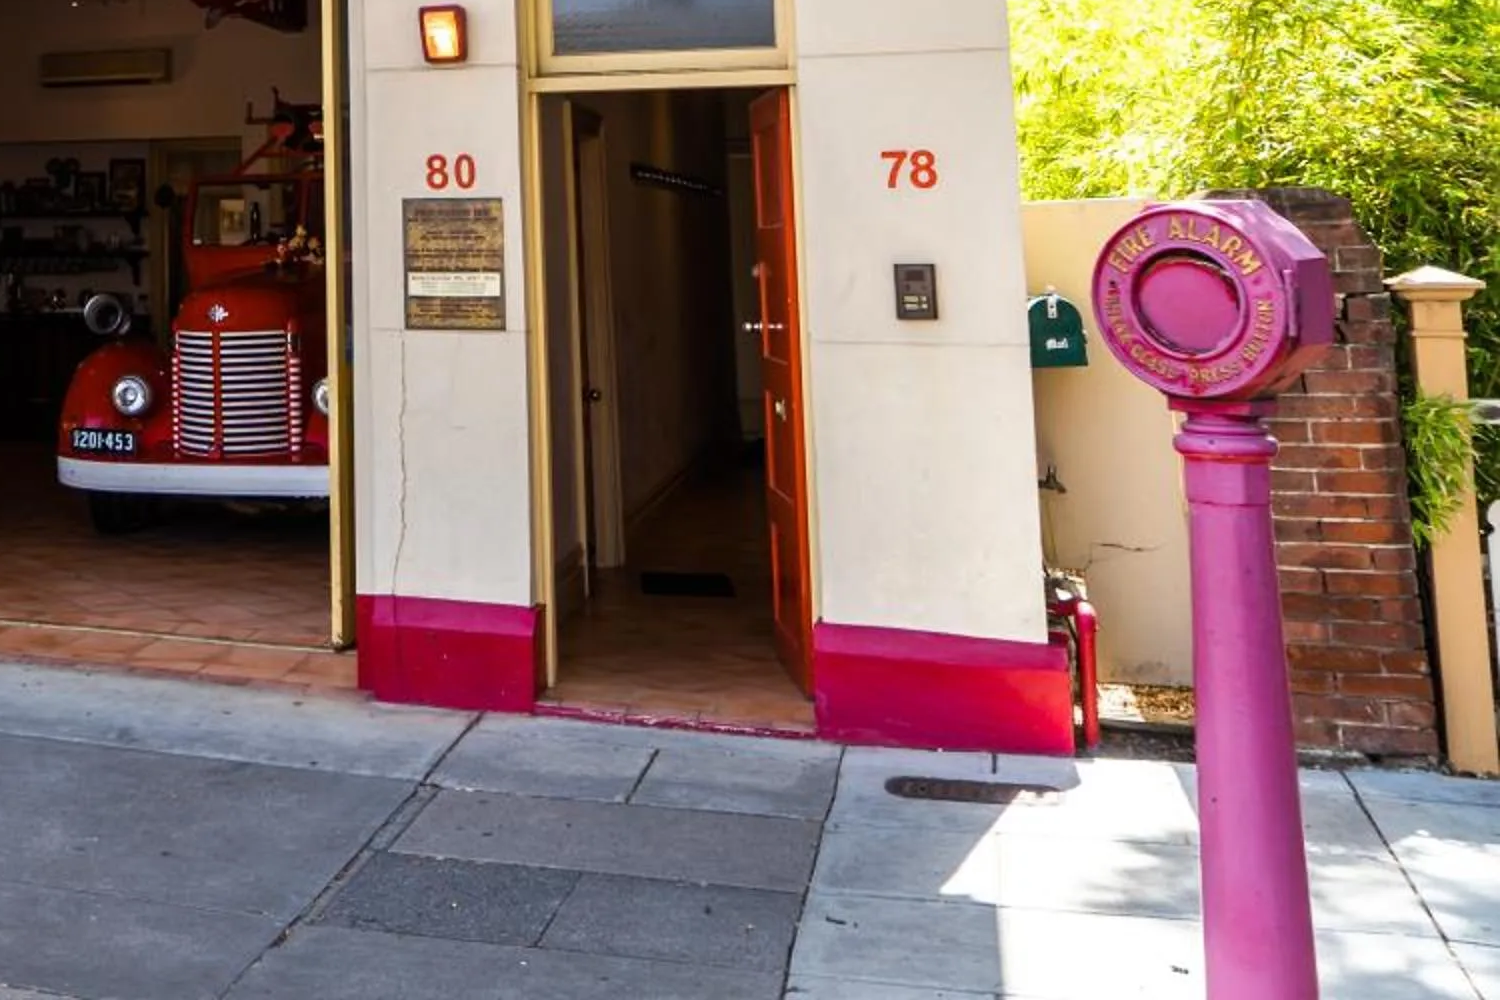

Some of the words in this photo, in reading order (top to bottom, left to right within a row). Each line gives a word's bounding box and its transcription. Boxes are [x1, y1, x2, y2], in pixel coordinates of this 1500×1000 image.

[426, 153, 476, 190] 80
[880, 149, 938, 190] 78
[1108, 225, 1155, 273] FIRE
[1168, 215, 1261, 275] ALARM
